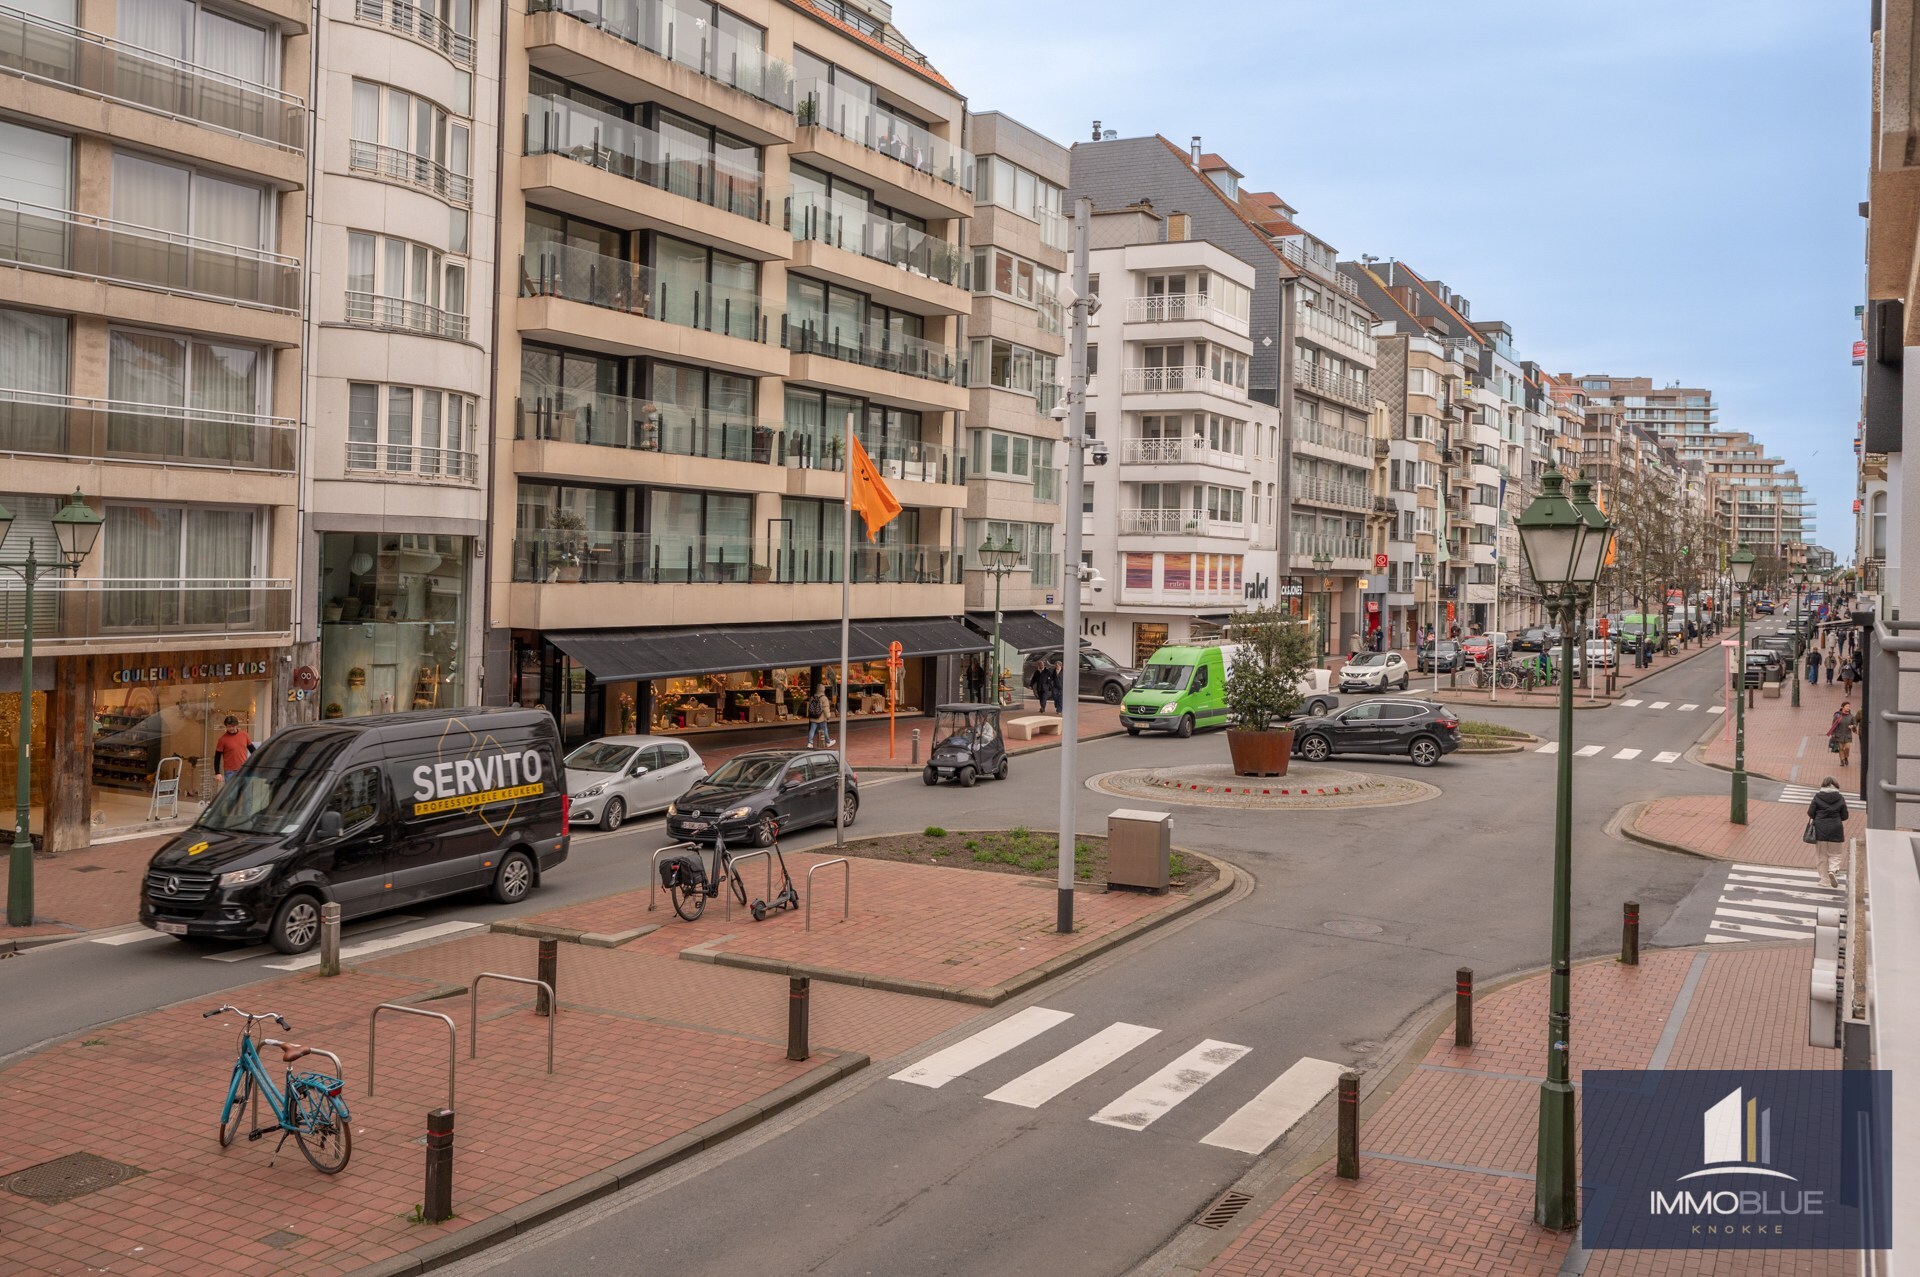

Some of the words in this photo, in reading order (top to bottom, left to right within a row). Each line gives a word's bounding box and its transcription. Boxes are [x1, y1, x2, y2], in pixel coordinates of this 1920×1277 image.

[1080, 617, 1106, 637] let
[112, 667, 176, 683] COULEUR
[182, 663, 232, 679] LOCALE
[238, 661, 266, 675] KIDS
[413, 750, 542, 801] SERVITO
[416, 792, 497, 812] PROFESSIONELE
[502, 784, 544, 798] KEUKENS
